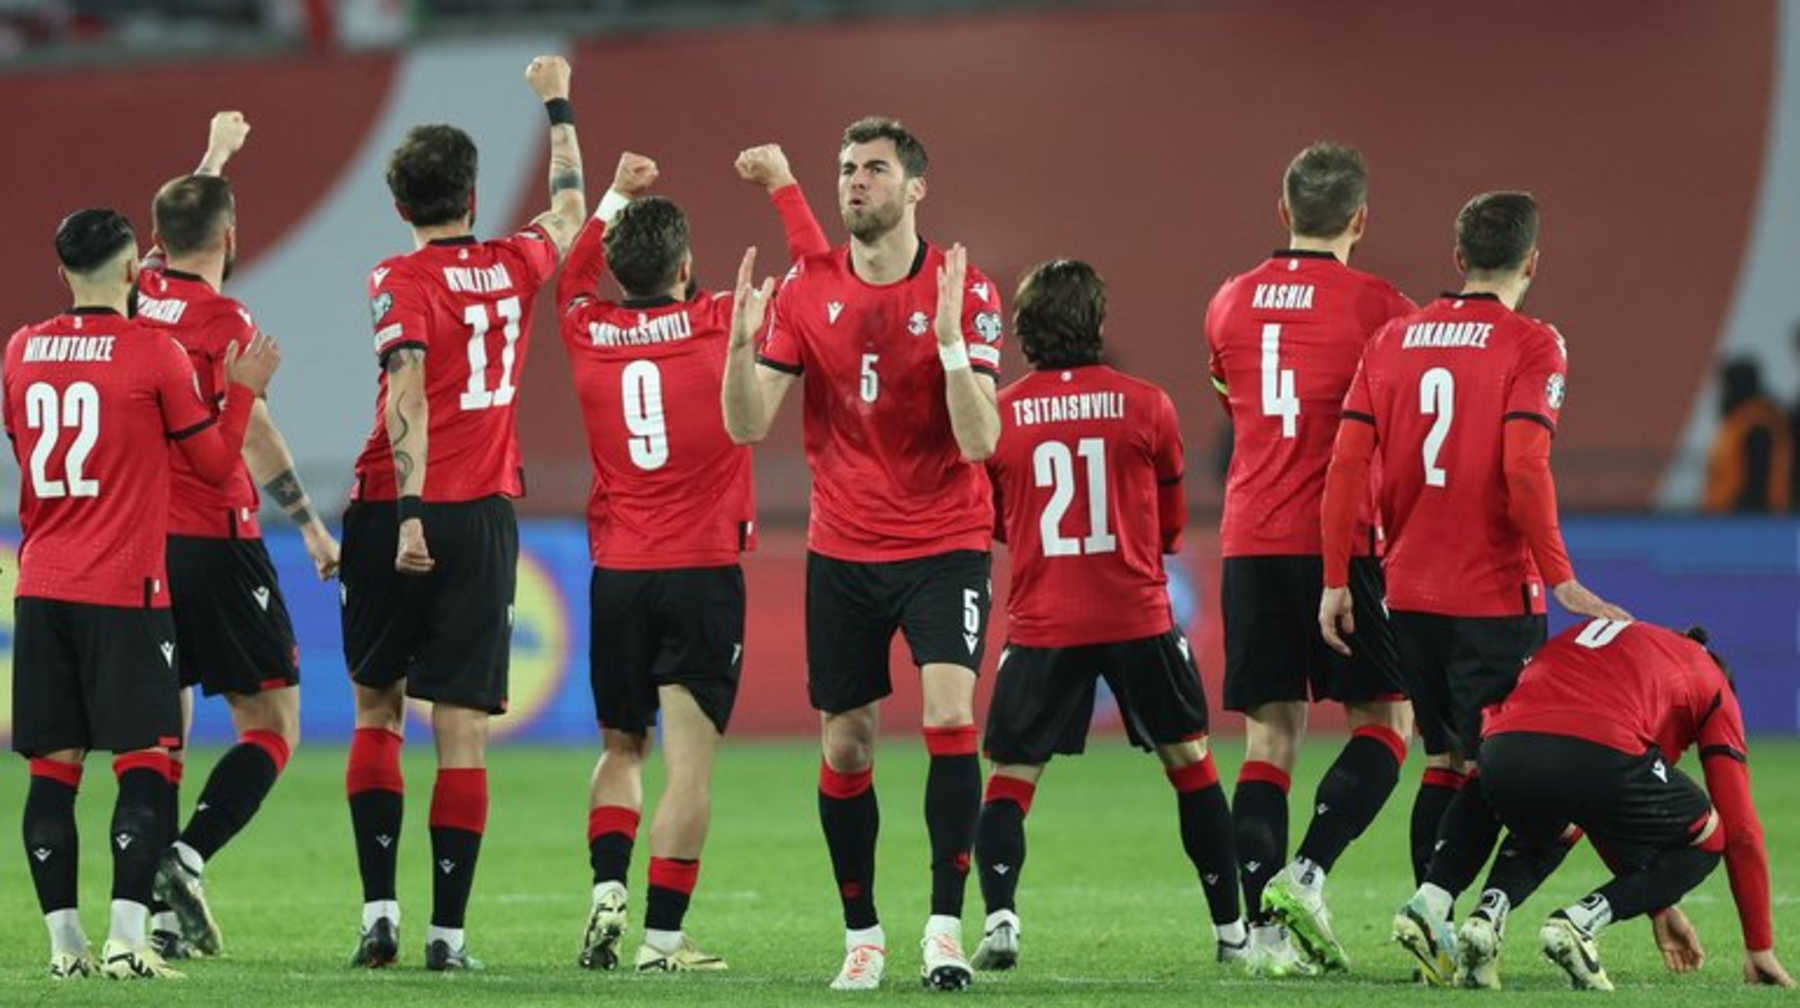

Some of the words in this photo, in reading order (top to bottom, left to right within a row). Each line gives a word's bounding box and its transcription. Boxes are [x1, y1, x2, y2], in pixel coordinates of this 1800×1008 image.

[1252, 283, 1315, 309] KASHIA
[1402, 321, 1494, 349] KAKABADZE
[459, 296, 521, 410] 11
[860, 353, 879, 403] 5
[1012, 391, 1124, 427] TSITAISHVILI
[1262, 323, 1300, 438] 4
[26, 381, 99, 498] 22
[622, 359, 669, 471] 9
[1420, 367, 1454, 487] 2
[1033, 437, 1117, 557] 21
[963, 588, 980, 633] 5
